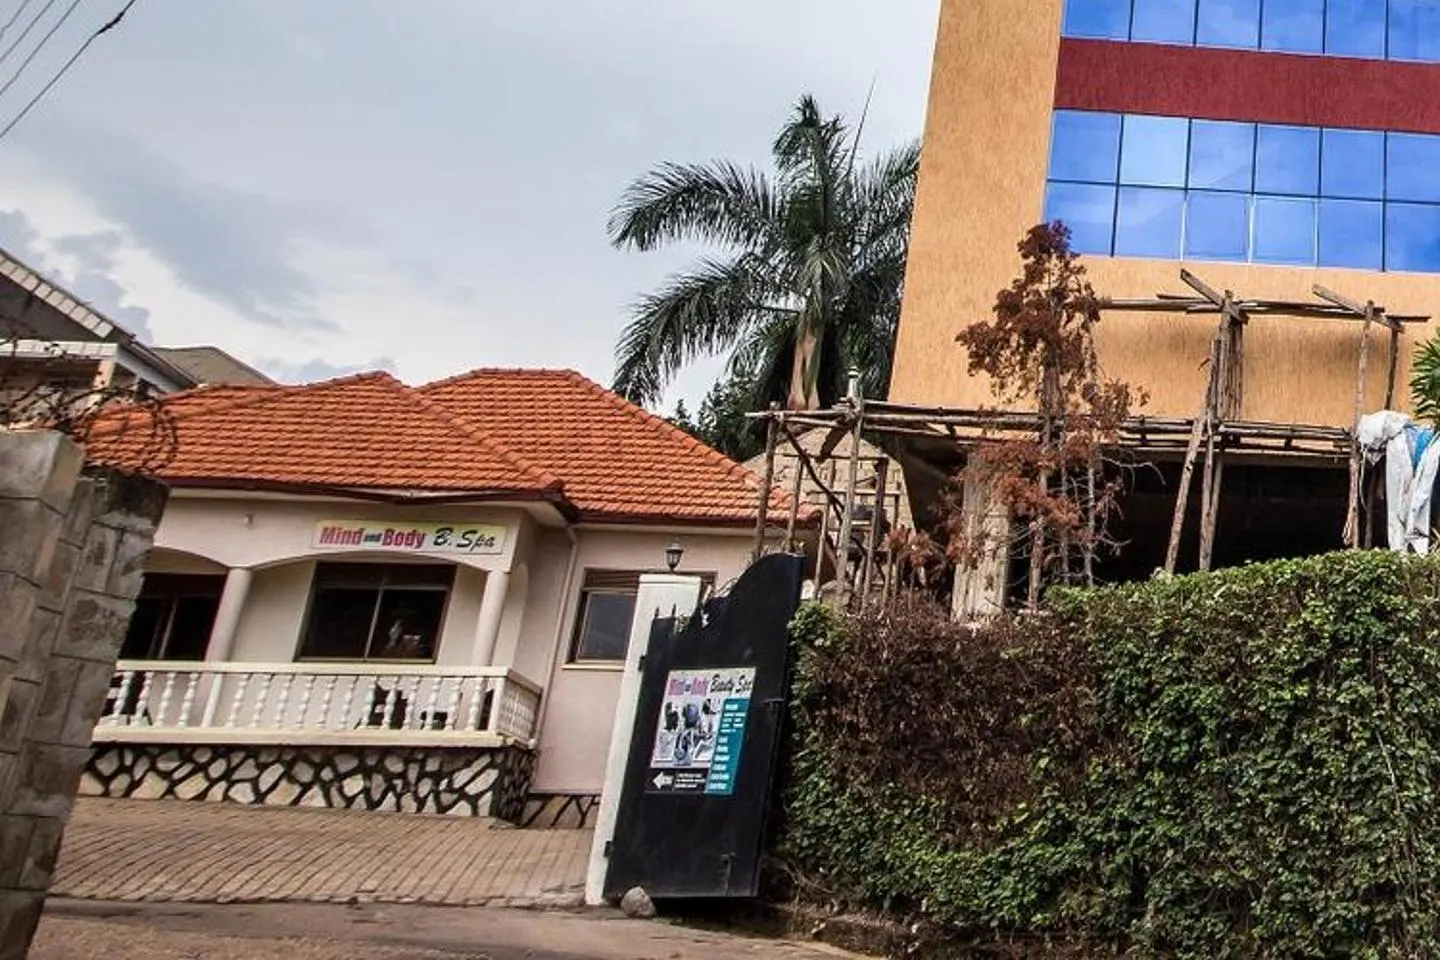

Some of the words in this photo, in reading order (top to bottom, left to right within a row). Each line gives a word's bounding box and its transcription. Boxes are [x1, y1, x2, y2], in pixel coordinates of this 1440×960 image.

[319, 526, 364, 545] Mind
[382, 527, 427, 548] Body
[456, 529, 496, 551] Spa
